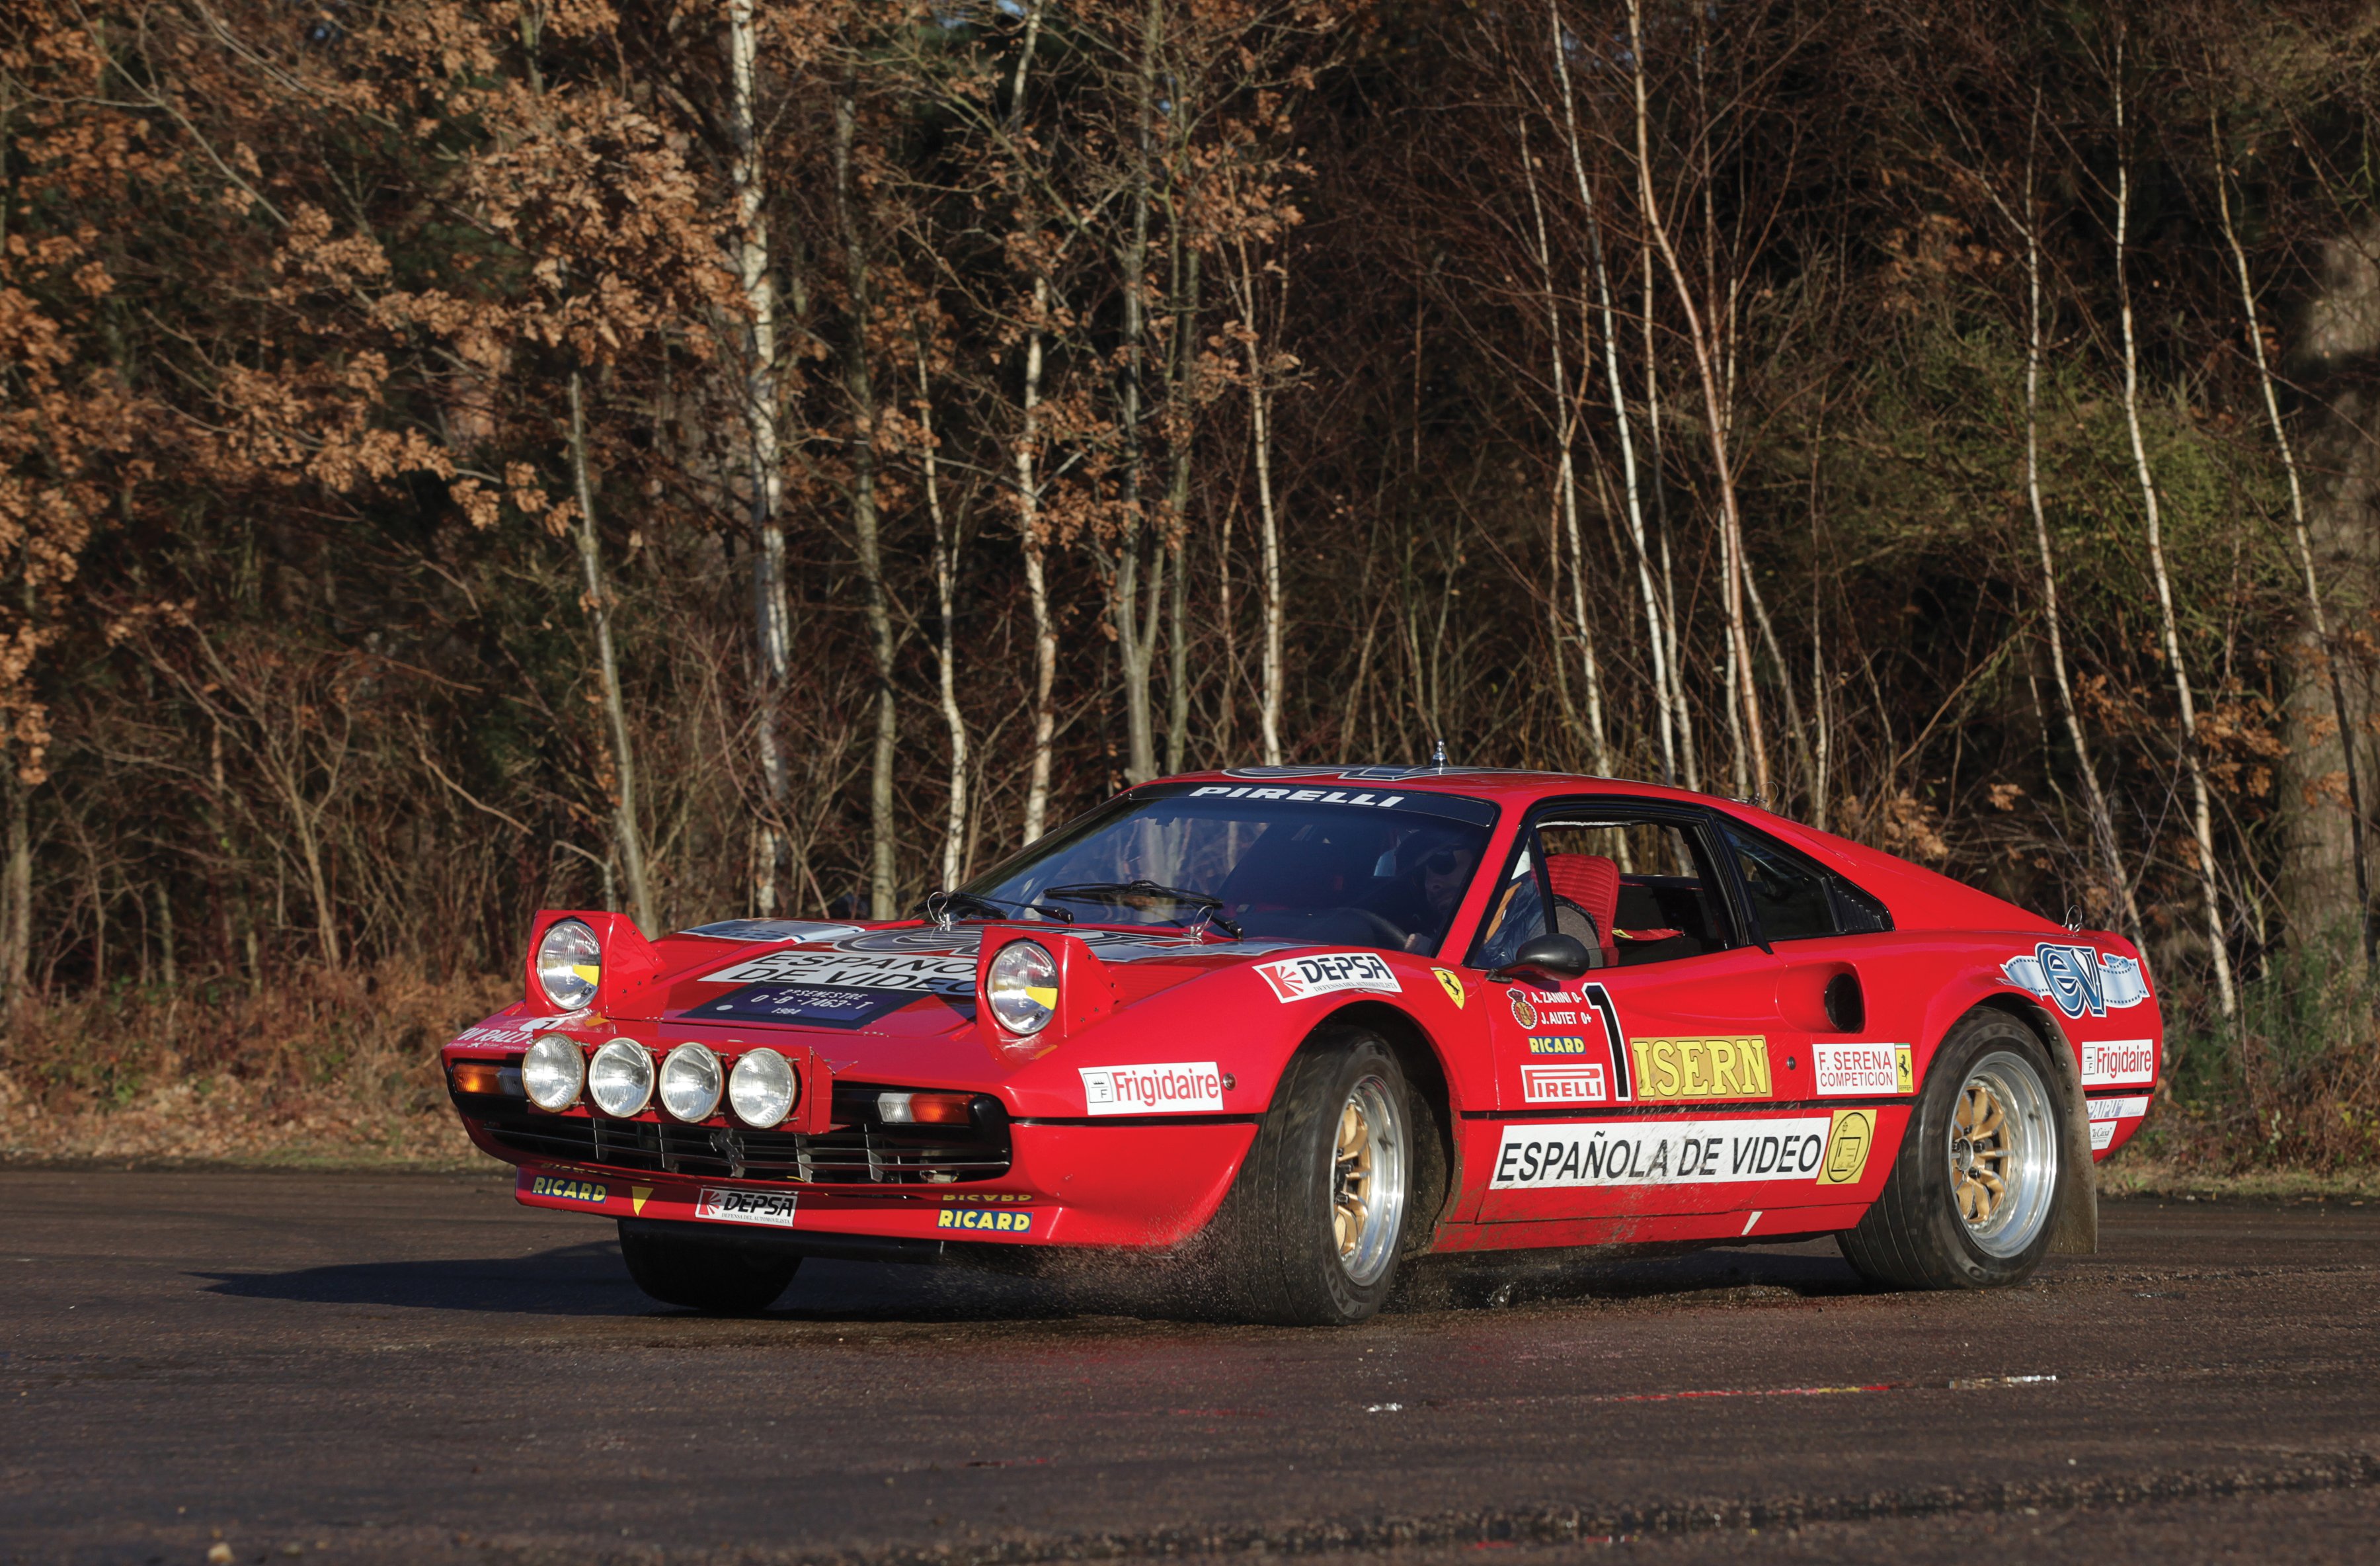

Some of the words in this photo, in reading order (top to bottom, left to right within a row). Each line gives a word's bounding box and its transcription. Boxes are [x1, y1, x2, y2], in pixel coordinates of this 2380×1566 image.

[1189, 786, 1404, 807] PIRELLI
[727, 968, 820, 981] DE
[751, 954, 976, 975] ESPAÑO
[1296, 956, 1392, 984] DEPSA
[1528, 1038, 1585, 1053] RICARD
[1583, 984, 1630, 1099] 1
[1632, 1039, 1767, 1096] ISERN
[1819, 1051, 1829, 1071] F.
[1833, 1051, 1893, 1071] SERENA
[2096, 1044, 2151, 1079] Frigidaire
[1111, 1068, 1219, 1106] Frigidaire
[1525, 1068, 1603, 1098] PIRELLI
[1820, 1072, 1893, 1087] COMPETICION
[1496, 1130, 1667, 1182] ESPAÑOLA
[1677, 1137, 1724, 1176] DE
[1732, 1134, 1821, 1174] VIDEO
[532, 1176, 607, 1202] RICARD
[723, 1192, 794, 1217] DEPSA
[937, 1210, 1031, 1231] RICARD
